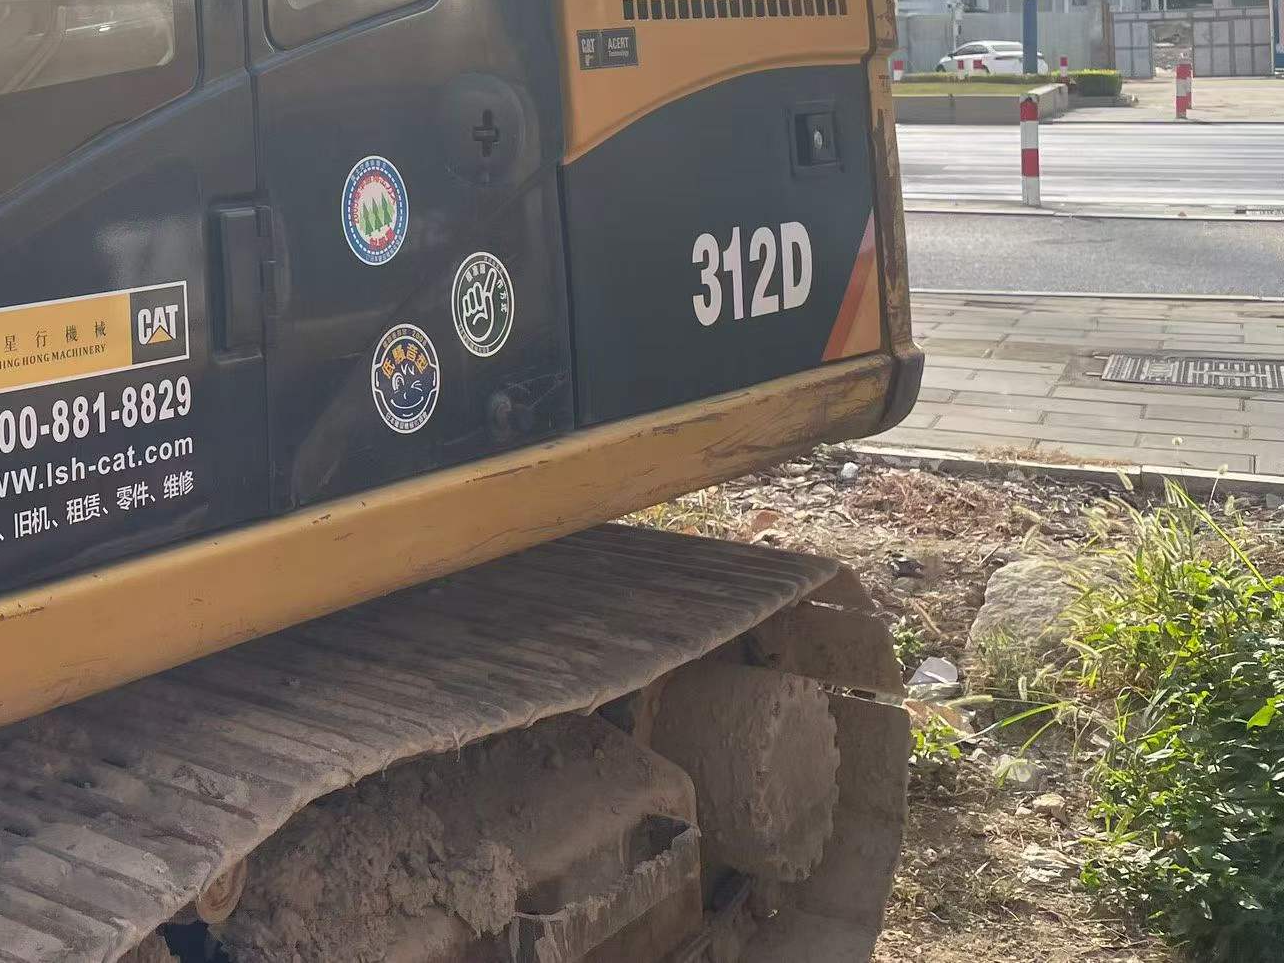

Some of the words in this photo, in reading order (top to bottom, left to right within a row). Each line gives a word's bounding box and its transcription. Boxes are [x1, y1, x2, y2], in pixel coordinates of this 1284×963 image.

[691, 221, 813, 326] 312D
[137, 304, 179, 346] CAT
[22, 353, 50, 367] HONG
[52, 344, 107, 361] MACHINERY
